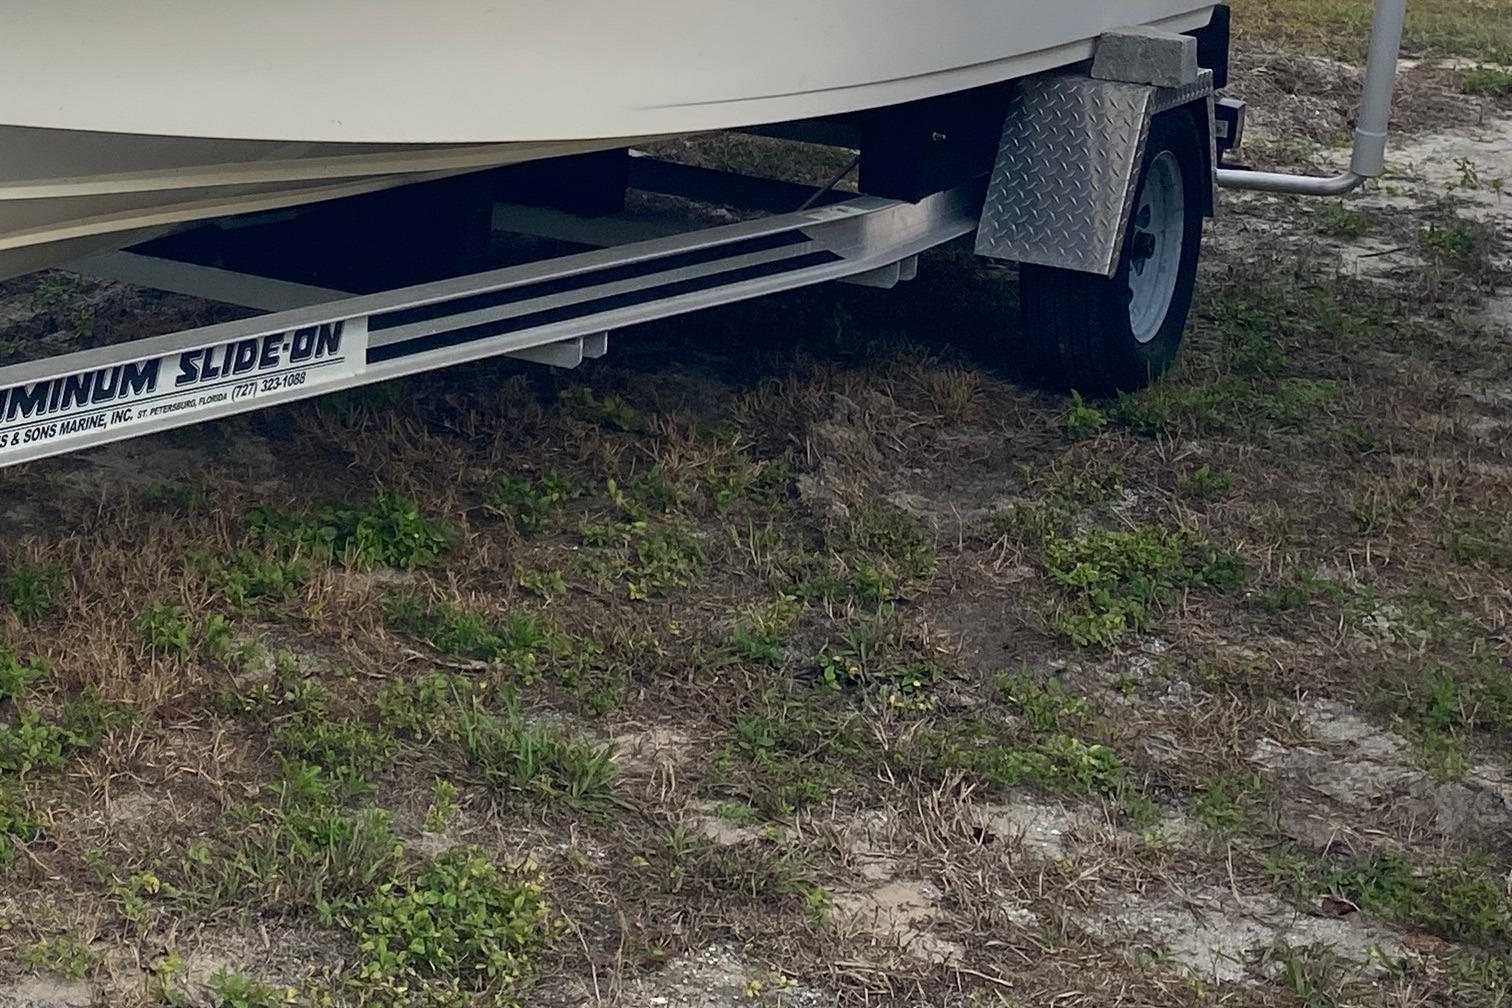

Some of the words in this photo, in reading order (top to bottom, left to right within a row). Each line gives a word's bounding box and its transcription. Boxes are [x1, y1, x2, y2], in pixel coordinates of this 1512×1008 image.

[174, 320, 346, 387] SLIDE-ON
[10, 427, 20, 446] &
[23, 422, 57, 444] SONS
[59, 412, 107, 435] MARINE,
[111, 406, 133, 425] INC.
[137, 407, 148, 419] ST.
[198, 391, 228, 407] FLORIDA
[231, 380, 258, 403] (727)
[261, 371, 306, 393] 323-1088
